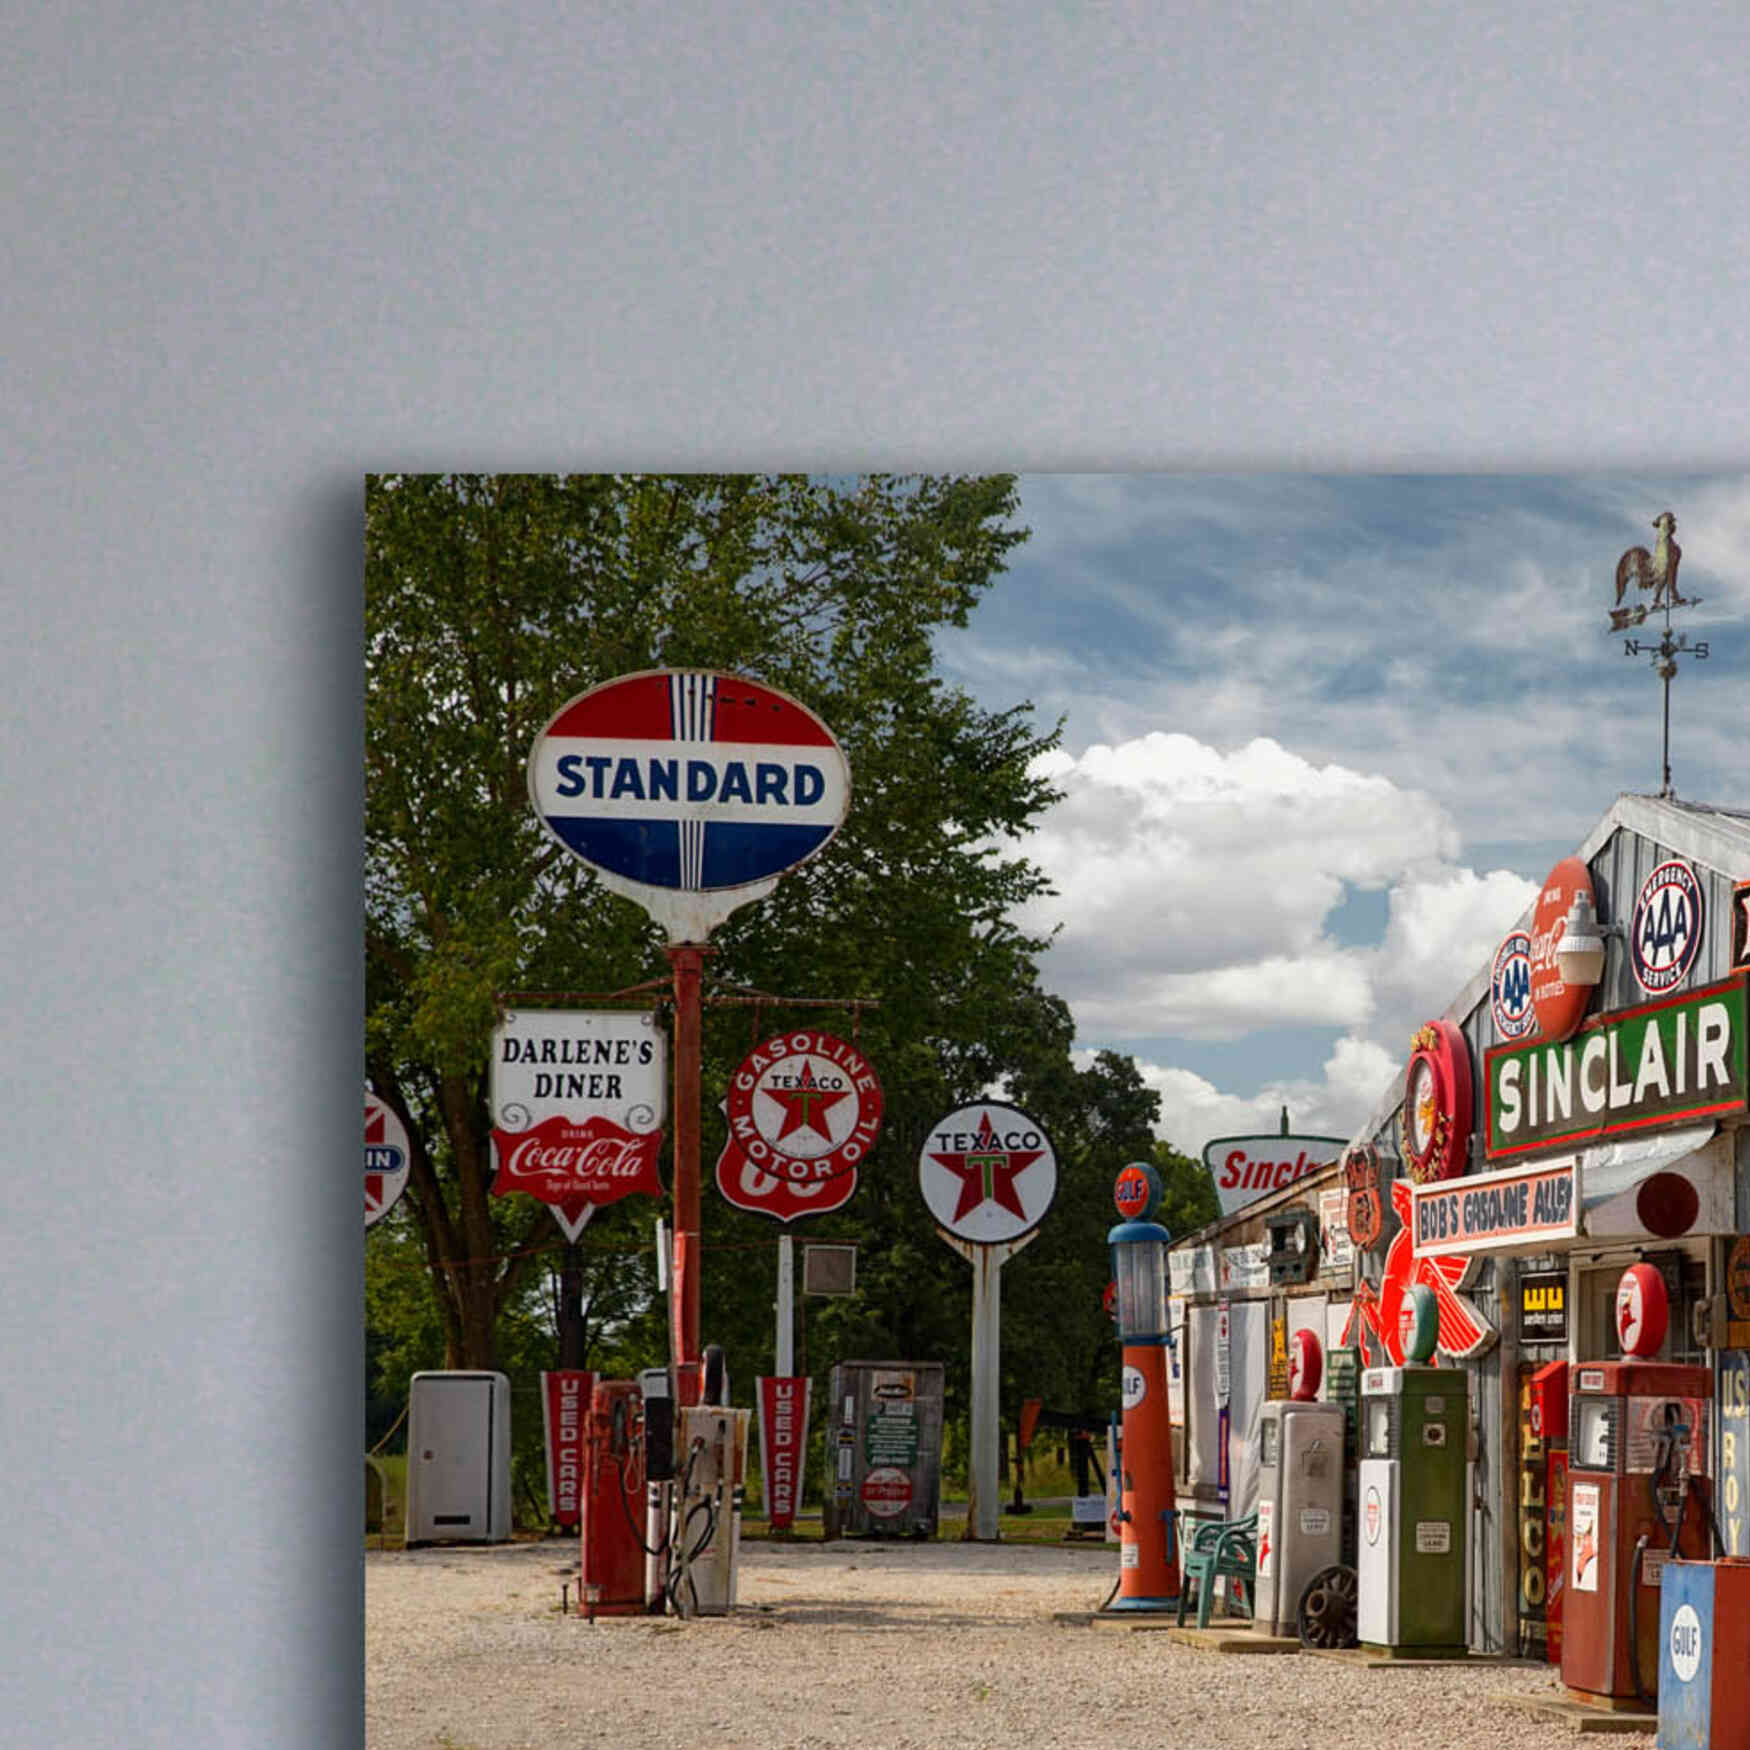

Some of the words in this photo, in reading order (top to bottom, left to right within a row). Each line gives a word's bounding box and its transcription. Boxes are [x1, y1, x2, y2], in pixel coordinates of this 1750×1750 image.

[1624, 640, 1640, 656] N
[556, 754, 826, 806] STANDARD
[1642, 887, 1688, 967] AAA
[502, 1038, 654, 1065] DARLENE'S
[736, 1033, 876, 1093] GASOLINE
[1499, 1002, 1731, 1132] SINCLAIR
[534, 1073, 623, 1100] DINER
[770, 1074, 843, 1091] TEXACO
[508, 1137, 646, 1178] Coca-Cola
[732, 1114, 834, 1179] MOTOR
[842, 1117, 880, 1163] OIL
[935, 1132, 1042, 1152] TEXACO
[1420, 1195, 1458, 1241] BOB'S
[1463, 1182, 1529, 1233] GASOLINE
[559, 1379, 578, 1442] USED
[775, 1385, 792, 1446] USED
[559, 1448, 578, 1511] CARS
[775, 1453, 792, 1514] CARS
[1673, 1625, 1697, 1657] GULF
